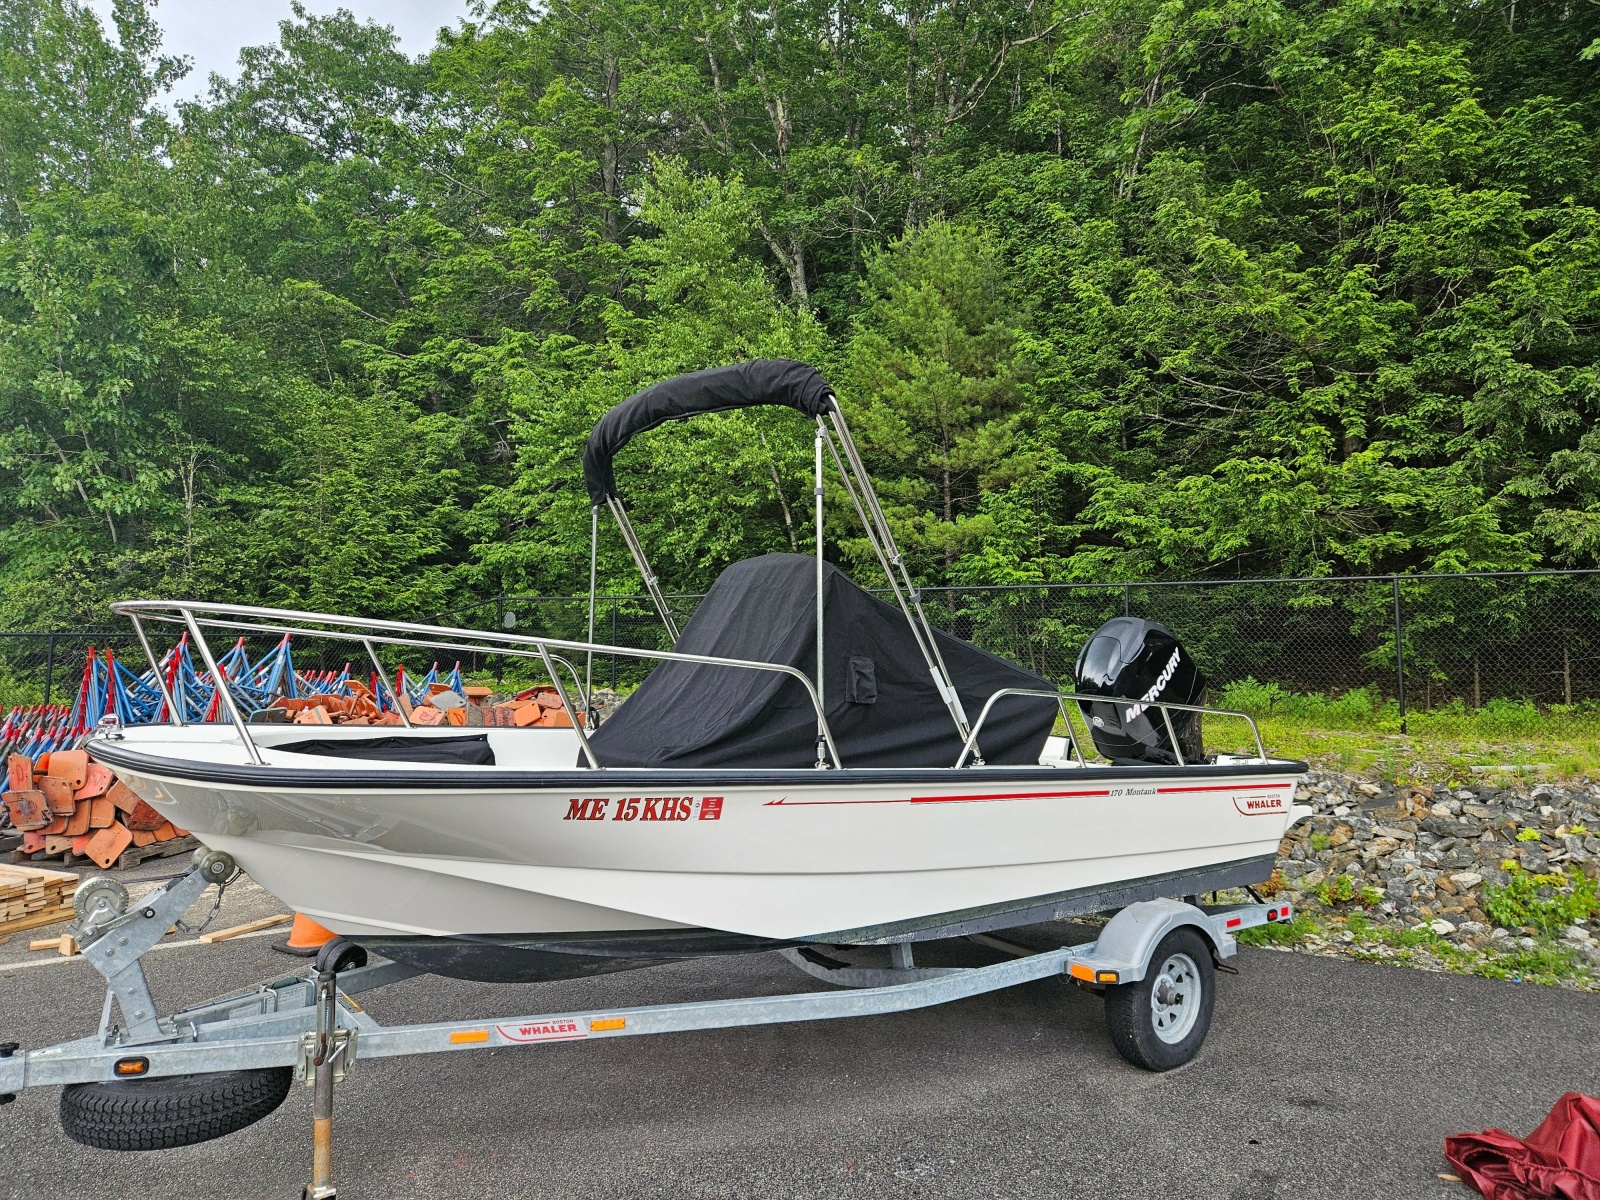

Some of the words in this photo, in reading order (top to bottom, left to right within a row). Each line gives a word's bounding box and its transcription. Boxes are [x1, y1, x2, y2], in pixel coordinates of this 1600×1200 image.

[1125, 646, 1181, 723] MERCURY
[1110, 789, 1123, 797] 170
[1125, 787, 1156, 796] Montauk
[563, 798, 610, 821] ME
[1246, 799, 1282, 809] WHALER
[518, 1023, 578, 1036] WHALER
